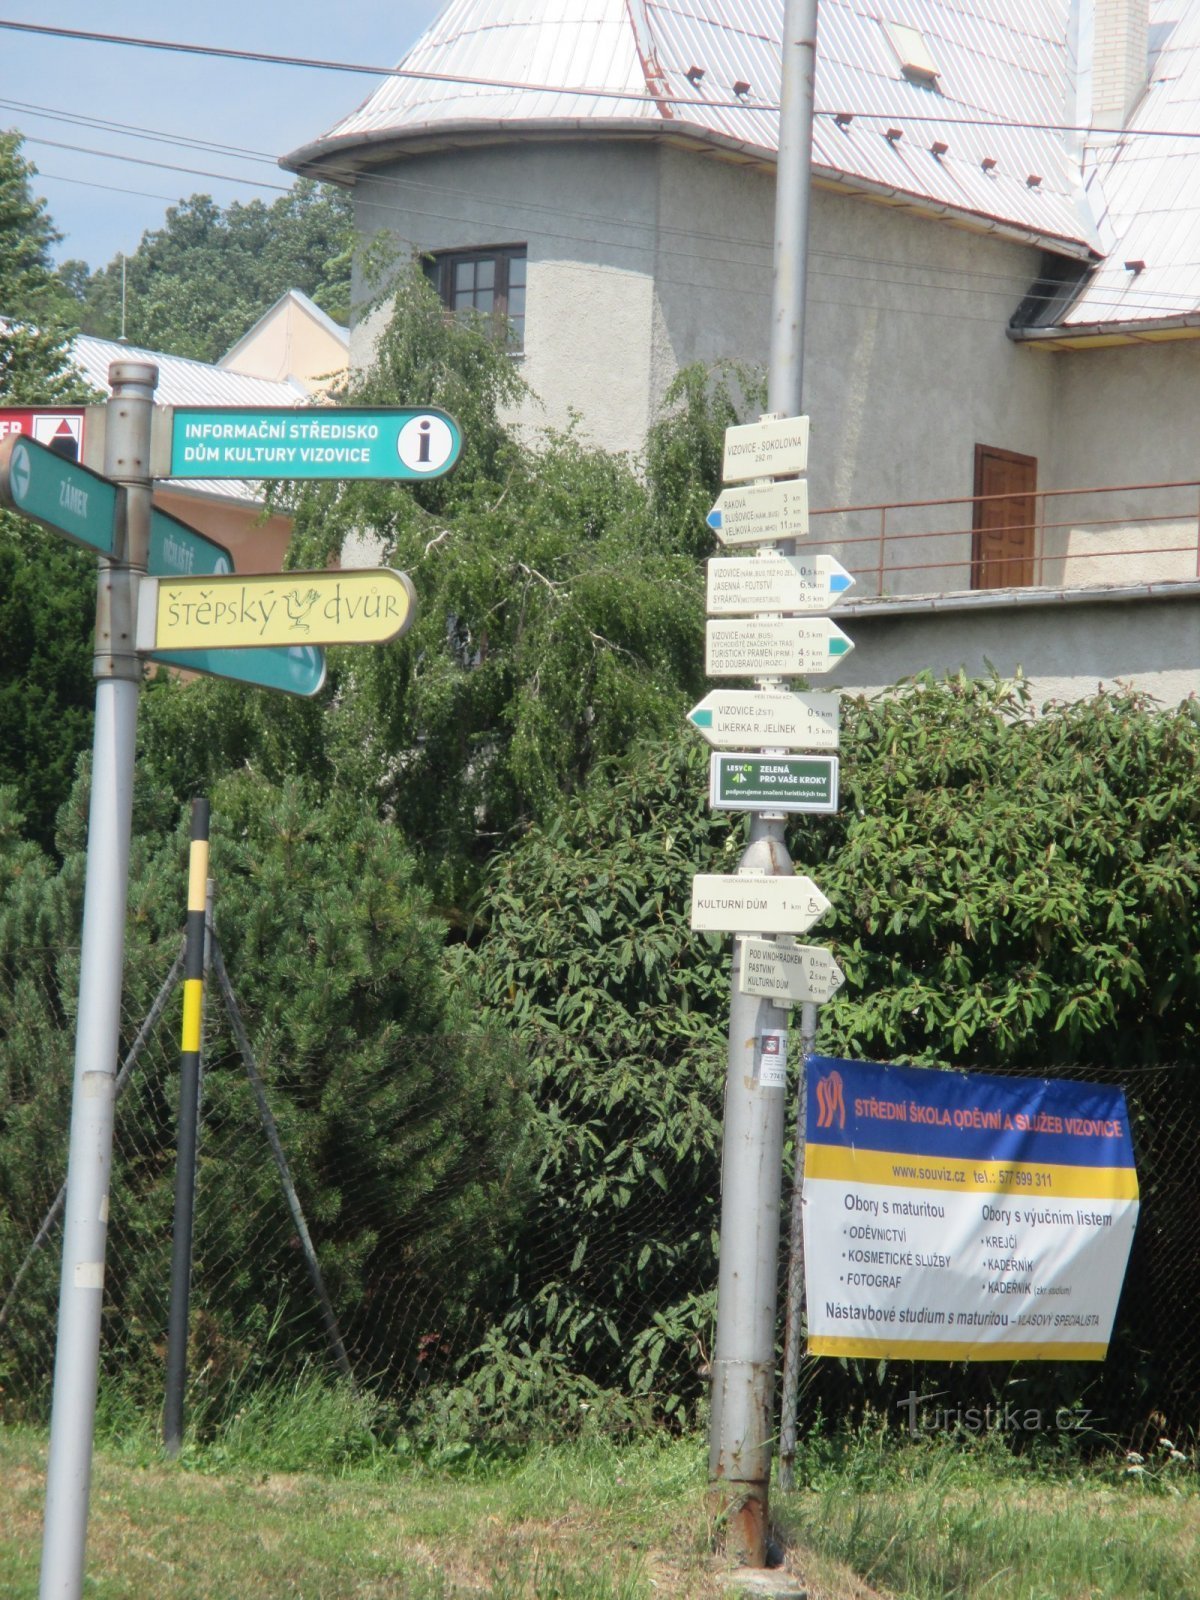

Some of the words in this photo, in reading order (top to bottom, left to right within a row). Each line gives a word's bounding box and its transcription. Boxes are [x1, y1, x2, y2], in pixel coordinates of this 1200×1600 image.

[185, 419, 286, 439] INFORMAČNÍ
[289, 420, 378, 440] STŘEDISKO
[184, 443, 220, 462] DŮM
[224, 447, 297, 463] KULTURY
[300, 447, 370, 463] VIZOVICE
[728, 442, 756, 456] VIZOVICE
[762, 437, 802, 451] SOKOLOVNA
[59, 477, 88, 519] ZÁMEK
[784, 494, 788, 503] 3
[725, 510, 754, 523] SLUŠOVICE
[784, 507, 788, 516] 5
[714, 568, 740, 578] VIZOVICE
[800, 567, 812, 575] 0,5
[714, 580, 740, 591] JASENNÁ
[745, 578, 772, 590] FOJTSTVÍ
[711, 631, 738, 640] VIZOVICE
[798, 630, 810, 638] 0,5
[711, 659, 724, 668] POD
[725, 659, 762, 668] DOUBRAVOU
[798, 659, 803, 667] 8
[719, 706, 754, 716] VIZOVICE
[808, 708, 820, 717] 0,5
[754, 724, 762, 732] R.
[764, 722, 796, 733] JELÍNEK
[760, 764, 789, 773] ZELENÁ
[760, 775, 776, 783] PRO
[777, 773, 797, 784] VAŠE
[800, 777, 826, 785] KROKY
[698, 897, 744, 909] KULTURNÍ
[746, 898, 767, 910] DŮM
[782, 901, 786, 910] 1
[750, 949, 761, 959] POD
[748, 963, 775, 974] PASTVINY
[747, 976, 776, 989] KULTURNÍ
[776, 978, 788, 989] DŮM
[854, 1096, 907, 1122] STŘEDNÍ
[909, 1102, 952, 1127] ŠKOLA
[954, 1106, 1002, 1130] ODĚVNÍ
[1004, 1116, 1013, 1131] A
[1015, 1113, 1063, 1135] SLUŽEB
[1065, 1118, 1123, 1138] VIZOVICE
[892, 1165, 966, 1183] www.souviz.cz
[999, 1169, 1015, 1186] 577
[1016, 1171, 1032, 1186] 599
[1035, 1173, 1052, 1187] 311
[844, 1194, 879, 1214] Obory
[882, 1202, 889, 1214] s
[892, 1201, 945, 1218] maturitou
[982, 1205, 1011, 1228] Obory
[1015, 1211, 1021, 1223] s
[1023, 1209, 1074, 1227] výučním
[1076, 1209, 1112, 1226] listem
[850, 1225, 907, 1243] ODĚVNICTVÍ
[986, 1234, 1018, 1249] KREJČÍ
[848, 1249, 913, 1267] KOSMETICKÉ
[915, 1252, 951, 1269] SLUŽBY
[988, 1258, 1033, 1273] KADEŘNÍK
[846, 1272, 902, 1289] FOTOGRAF
[988, 1280, 1031, 1295] KADEŘNÍK
[826, 1302, 896, 1323] Nástavbové
[899, 1309, 946, 1326] studium
[948, 1314, 954, 1325] s
[957, 1310, 1008, 1327] maturitou
[1054, 1314, 1100, 1327] SPECIALISTA
